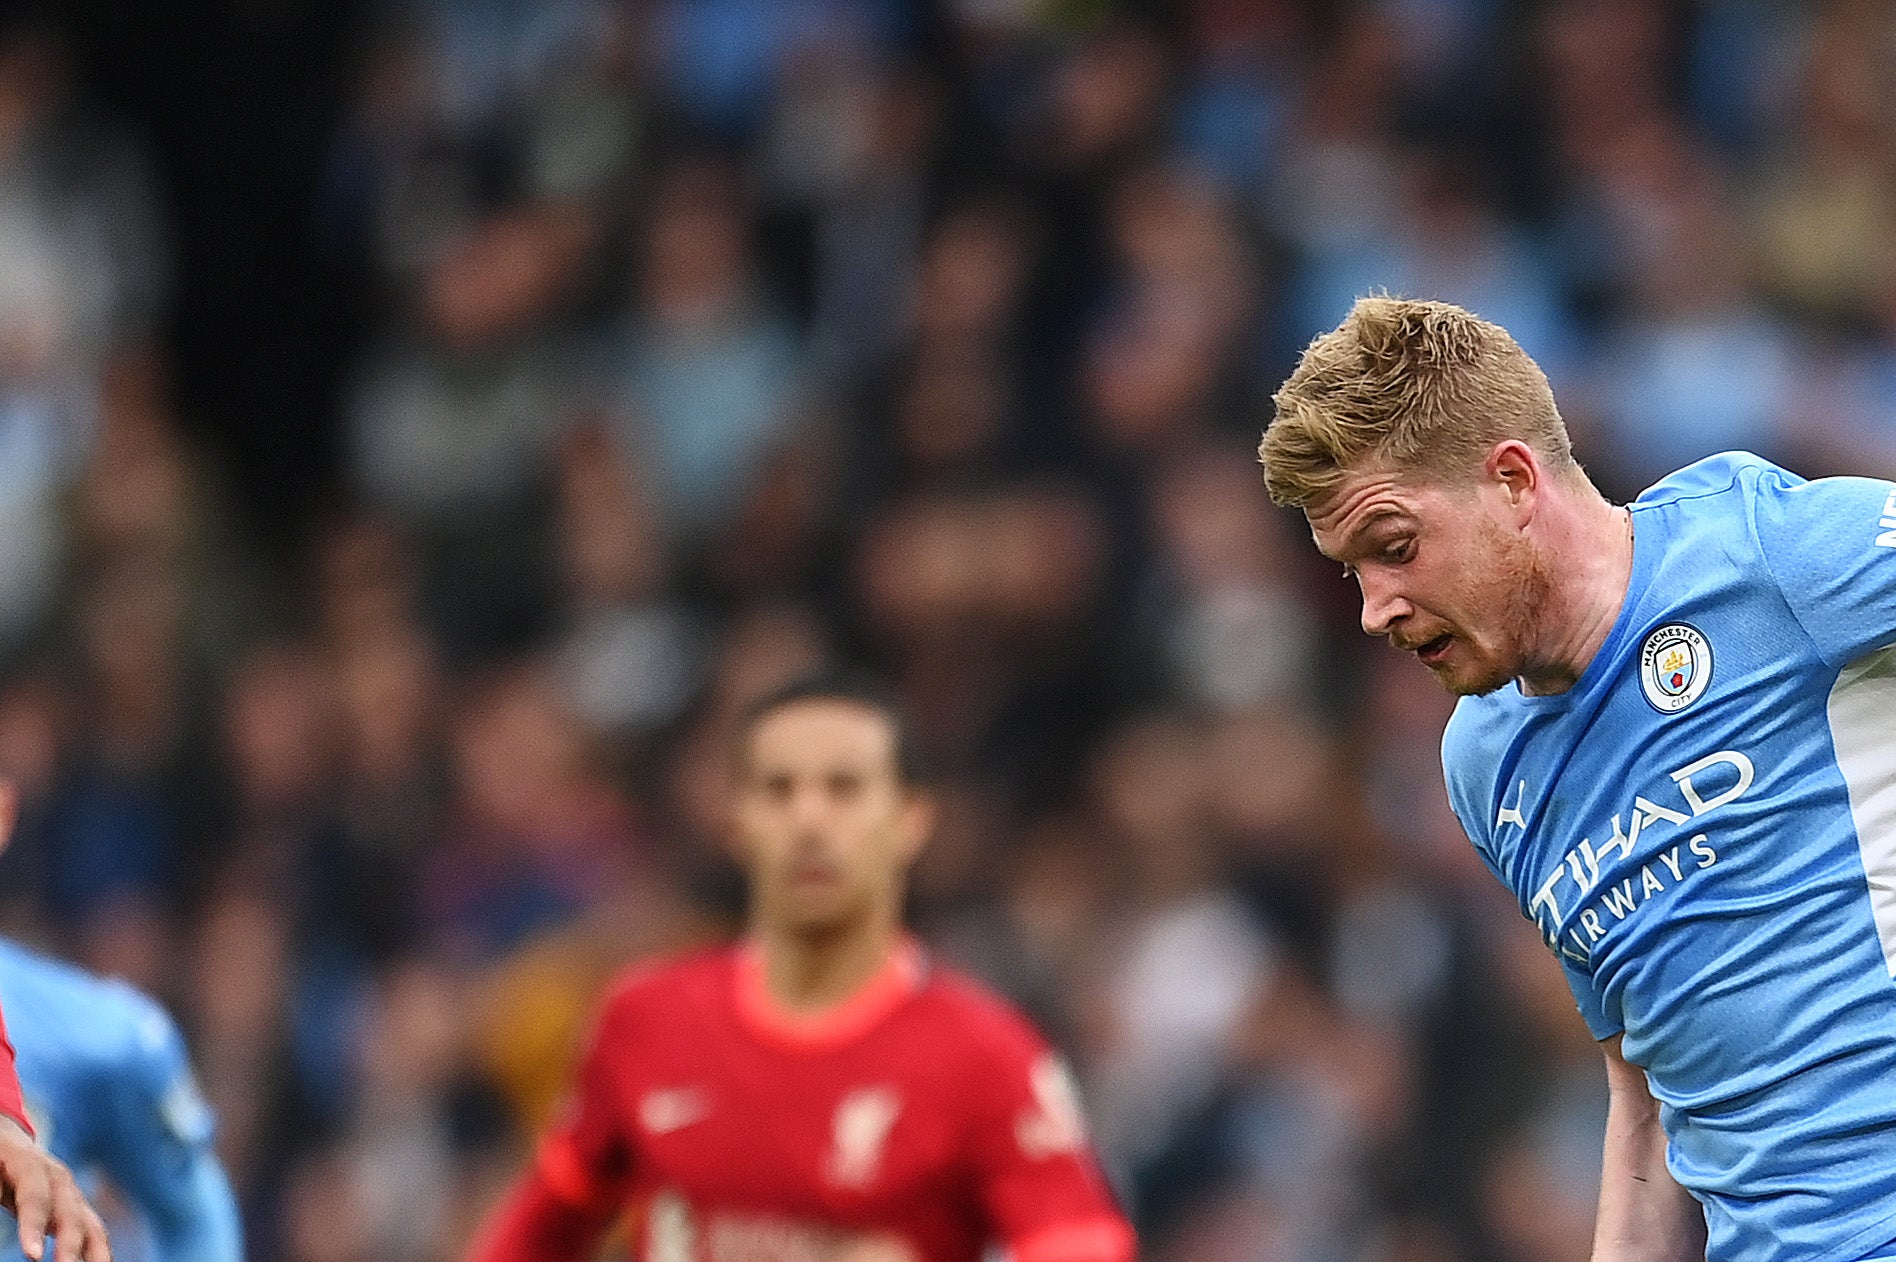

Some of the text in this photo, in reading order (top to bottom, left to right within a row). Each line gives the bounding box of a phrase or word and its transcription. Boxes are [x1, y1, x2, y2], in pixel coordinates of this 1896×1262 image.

[1644, 628, 1701, 667] MANCHESTER
[1671, 693, 1692, 708] CITY
[1532, 750, 1755, 944] TIHAD
